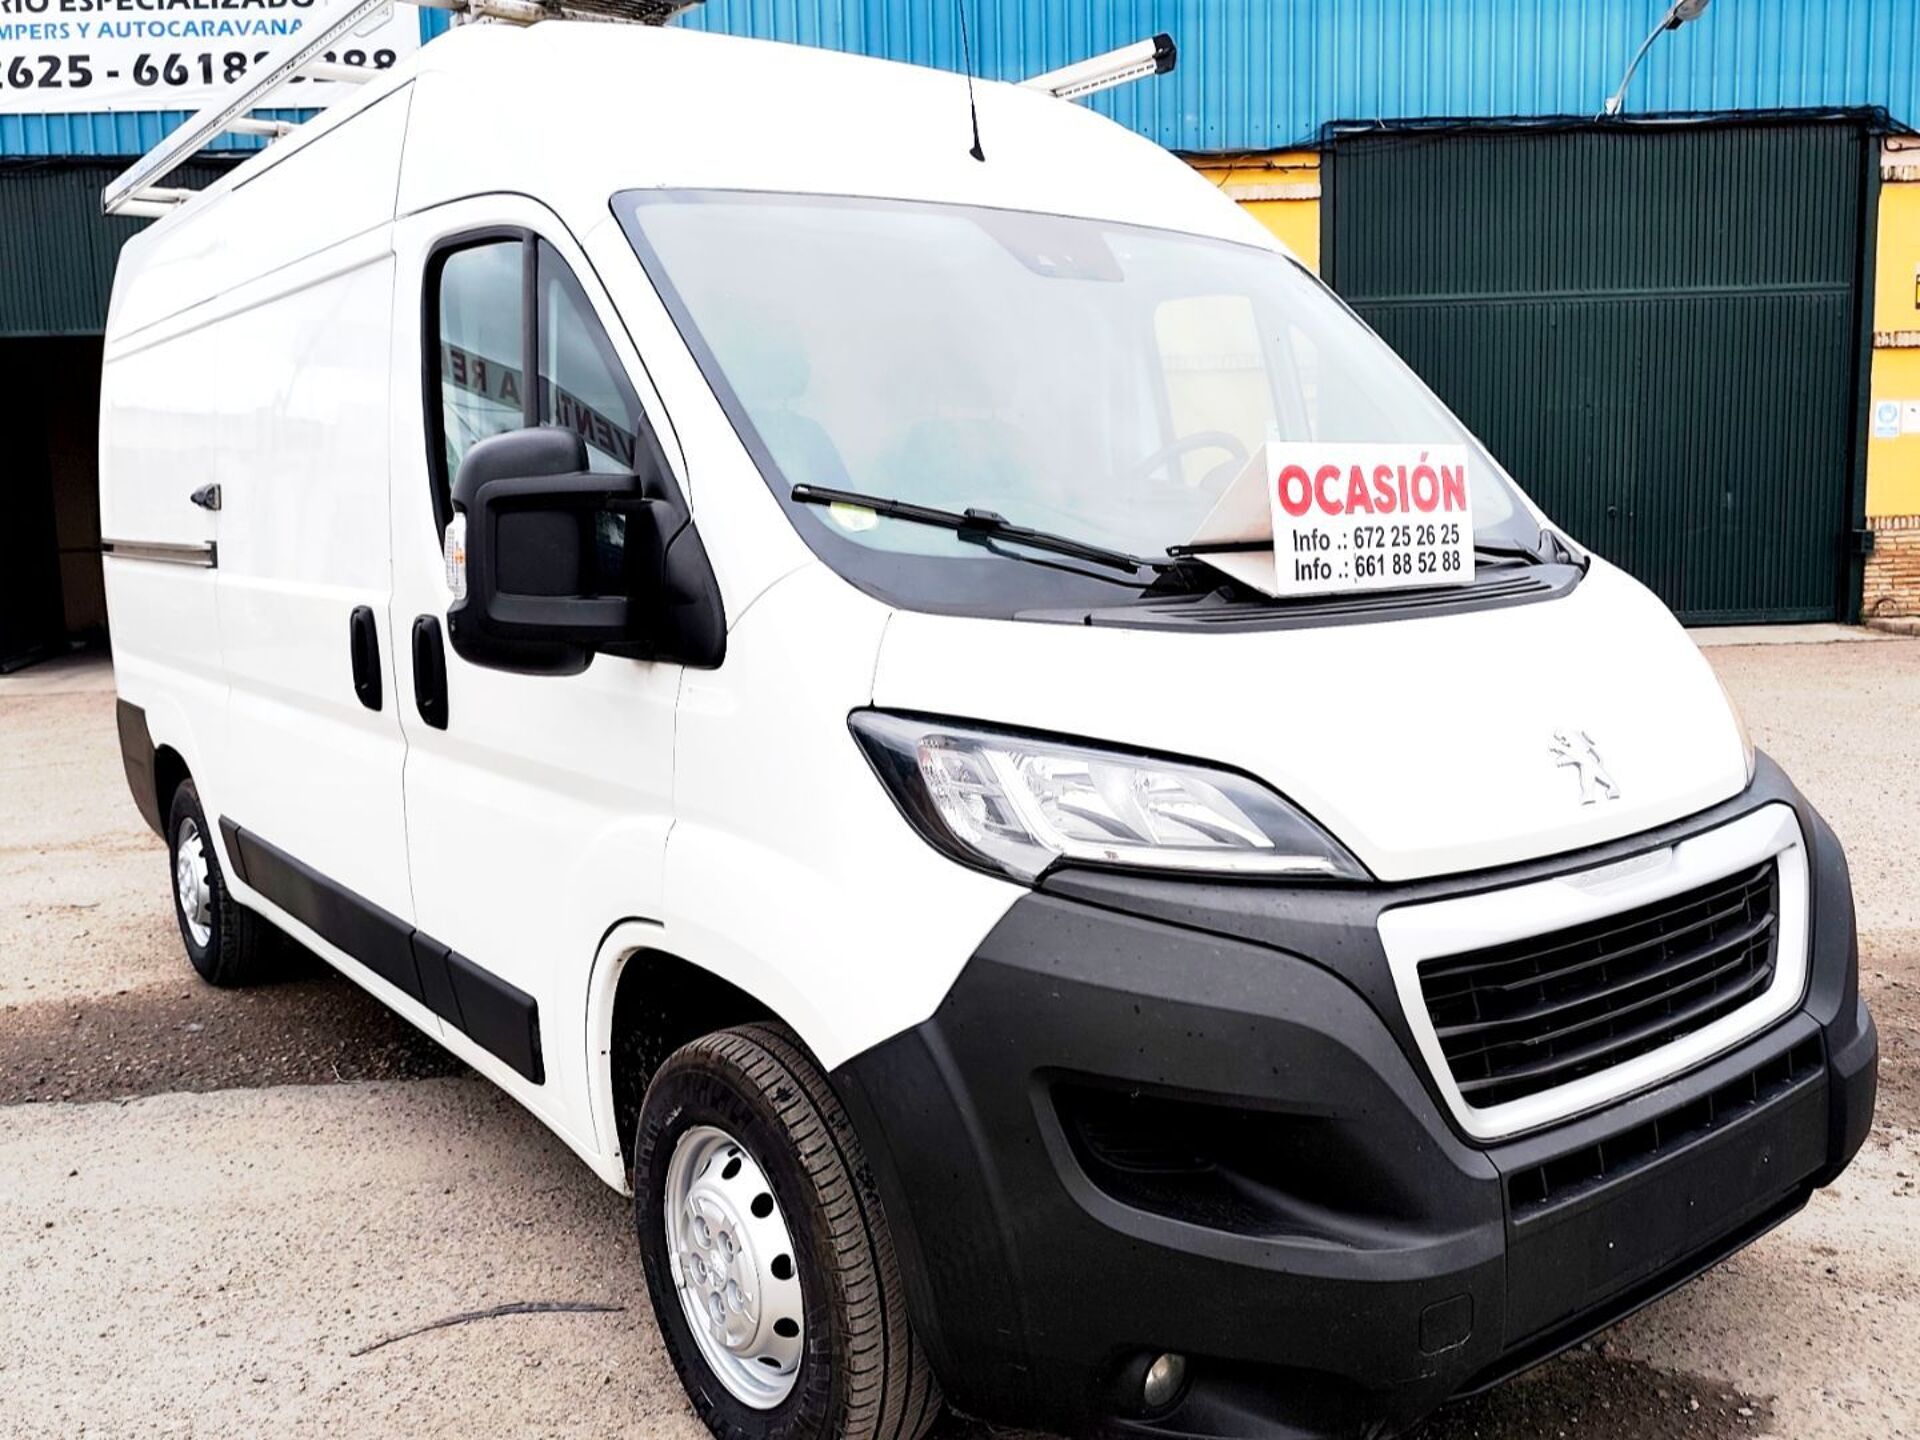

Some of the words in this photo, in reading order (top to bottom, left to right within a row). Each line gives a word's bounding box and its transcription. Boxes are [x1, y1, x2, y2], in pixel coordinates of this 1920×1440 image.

[77, 22, 91, 38] Y
[0, 54, 93, 89] 625
[1278, 452, 1467, 517] OCASIÓN
[1293, 527, 1331, 552] Info
[1353, 526, 1385, 550] 672
[1391, 525, 1412, 547] 25
[1416, 524, 1436, 546] 26
[1440, 523, 1460, 545] 25
[1295, 557, 1332, 581] Info
[1355, 553, 1385, 578] 661
[1392, 552, 1412, 575] 88
[1418, 551, 1437, 573] 52
[1442, 549, 1461, 572] 88
